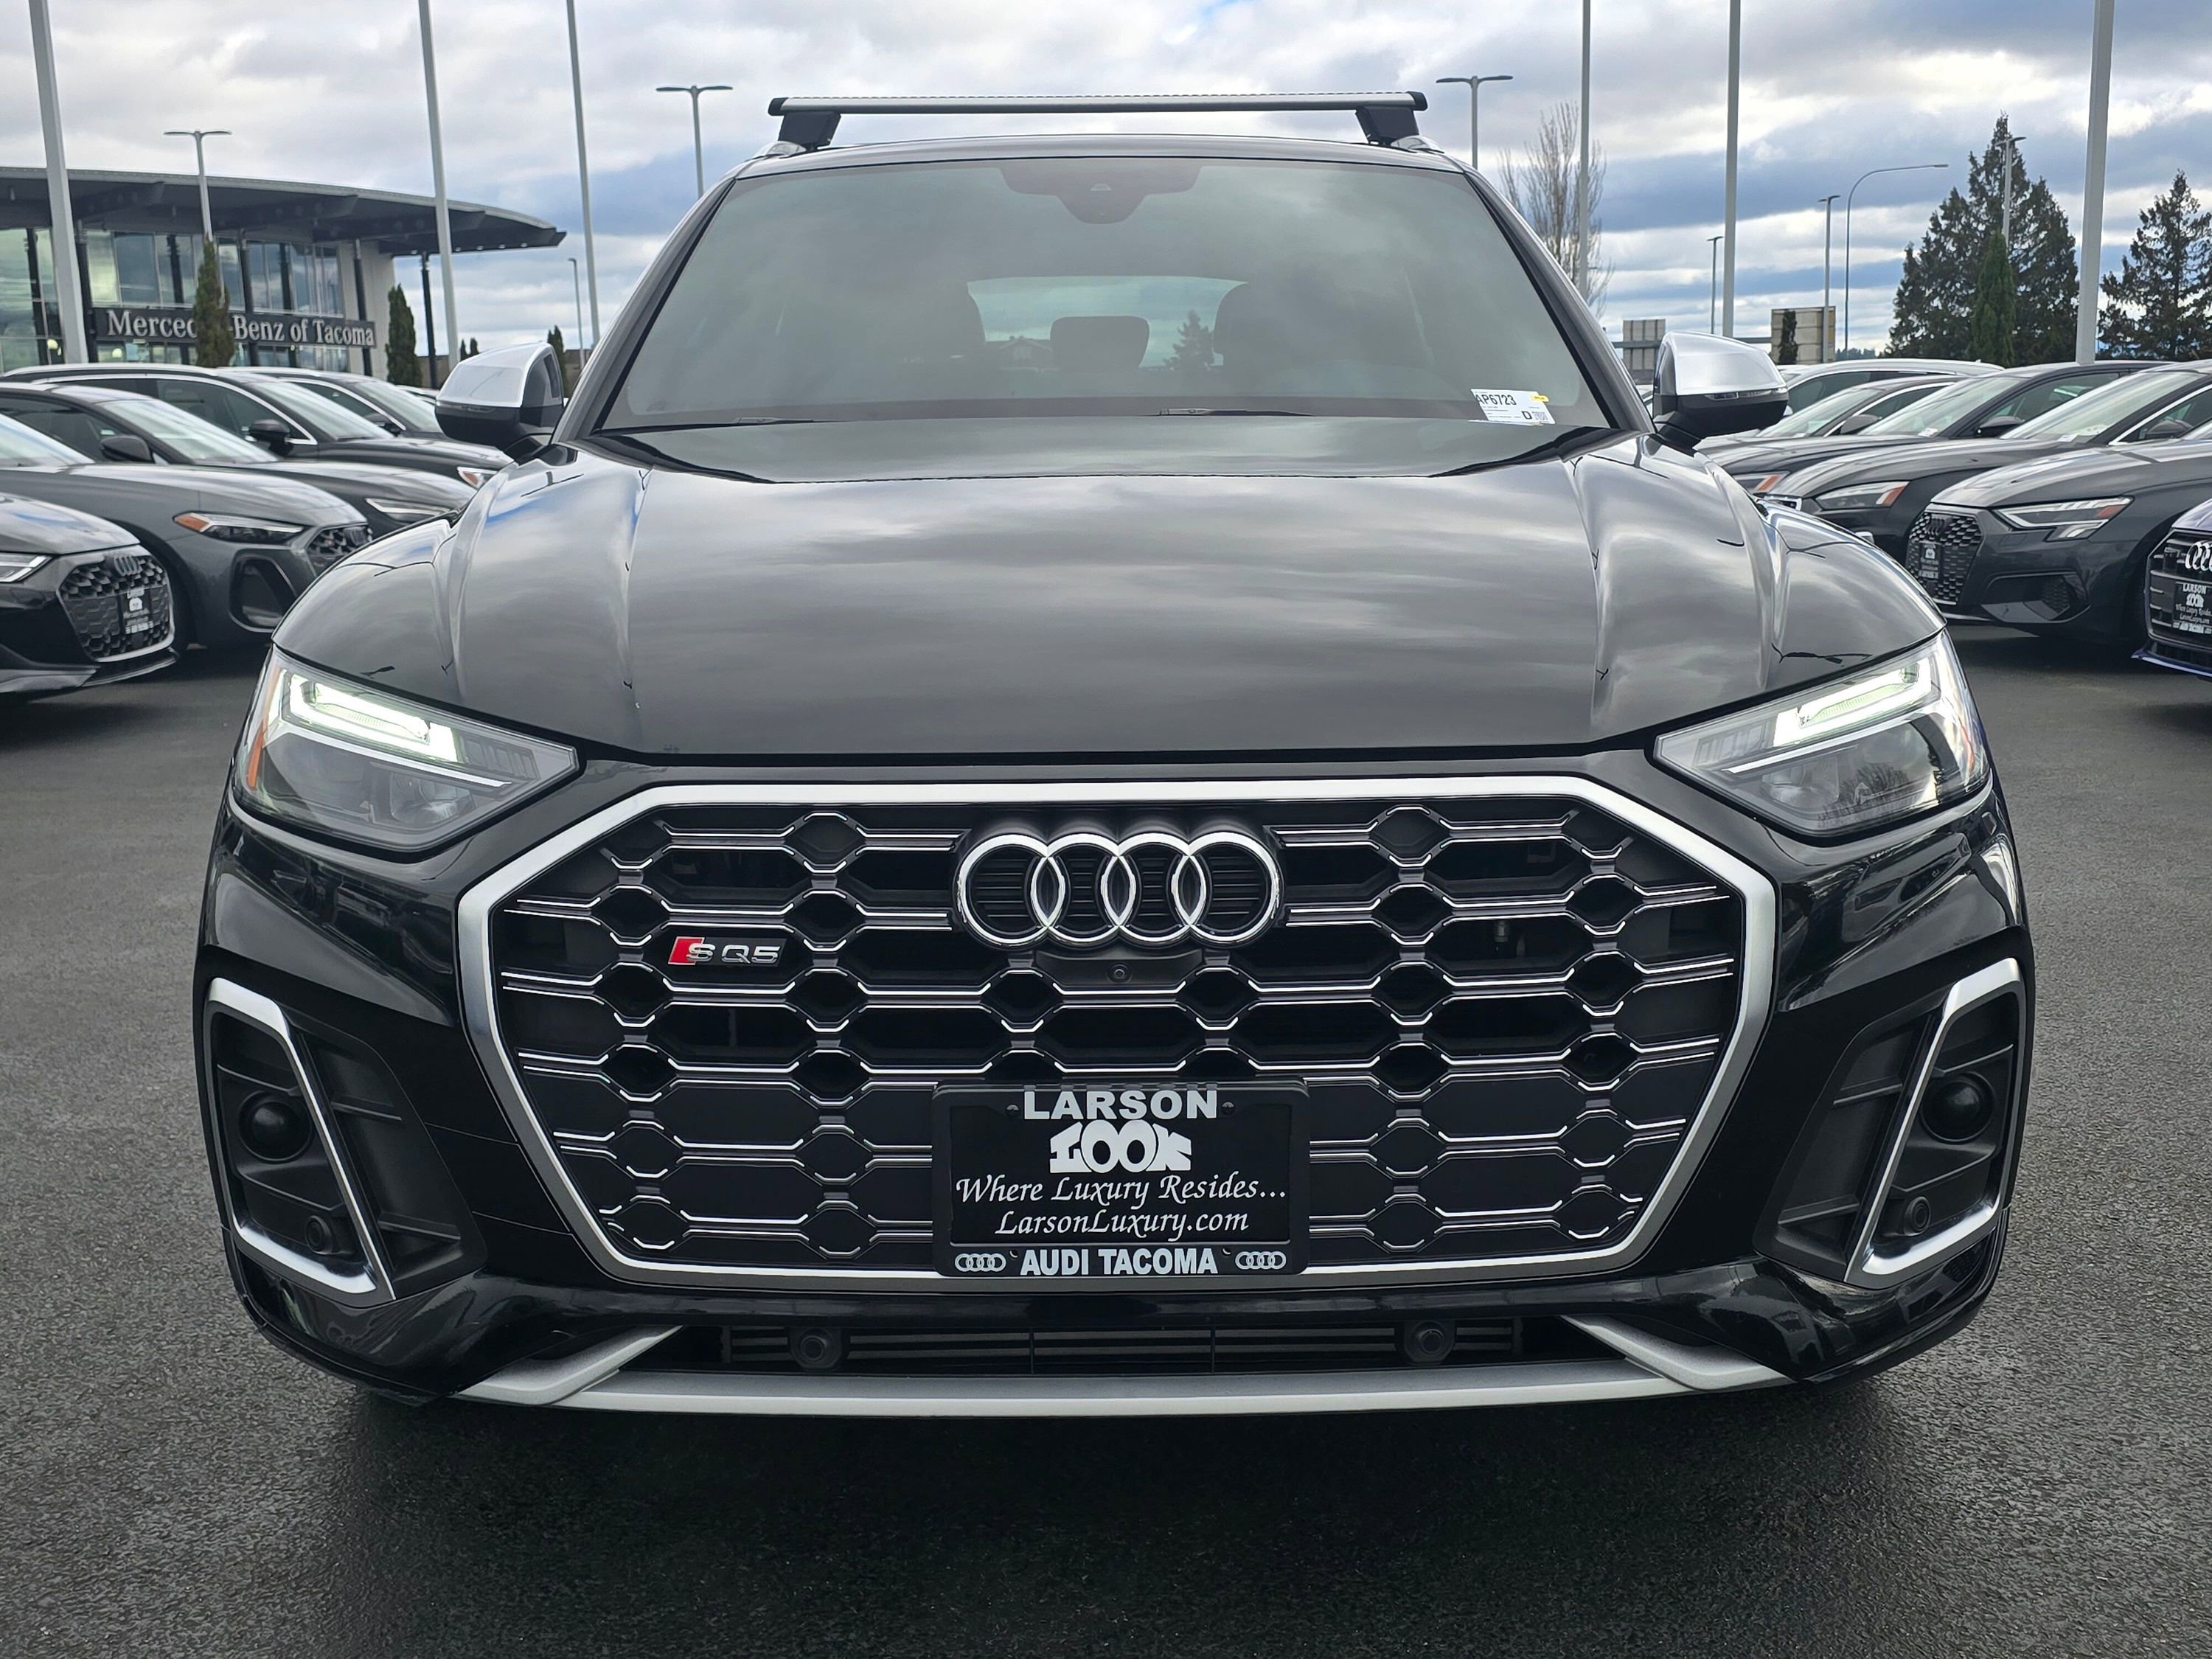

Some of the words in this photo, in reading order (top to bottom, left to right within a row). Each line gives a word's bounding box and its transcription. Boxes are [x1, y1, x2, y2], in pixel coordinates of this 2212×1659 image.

[290, 318, 309, 342] of
[312, 319, 375, 346] Tacoma
[686, 943, 781, 964] SQ5
[1023, 1090, 1217, 1119] LARSON
[956, 1174, 1043, 1203] Where
[1051, 1177, 1150, 1210] Luxury
[1158, 1171, 1286, 1204] Resides...
[995, 1209, 1250, 1242] LarsonLuxury.com
[1020, 1248, 1089, 1276] AUDI
[1098, 1248, 1218, 1275] TACOMA
